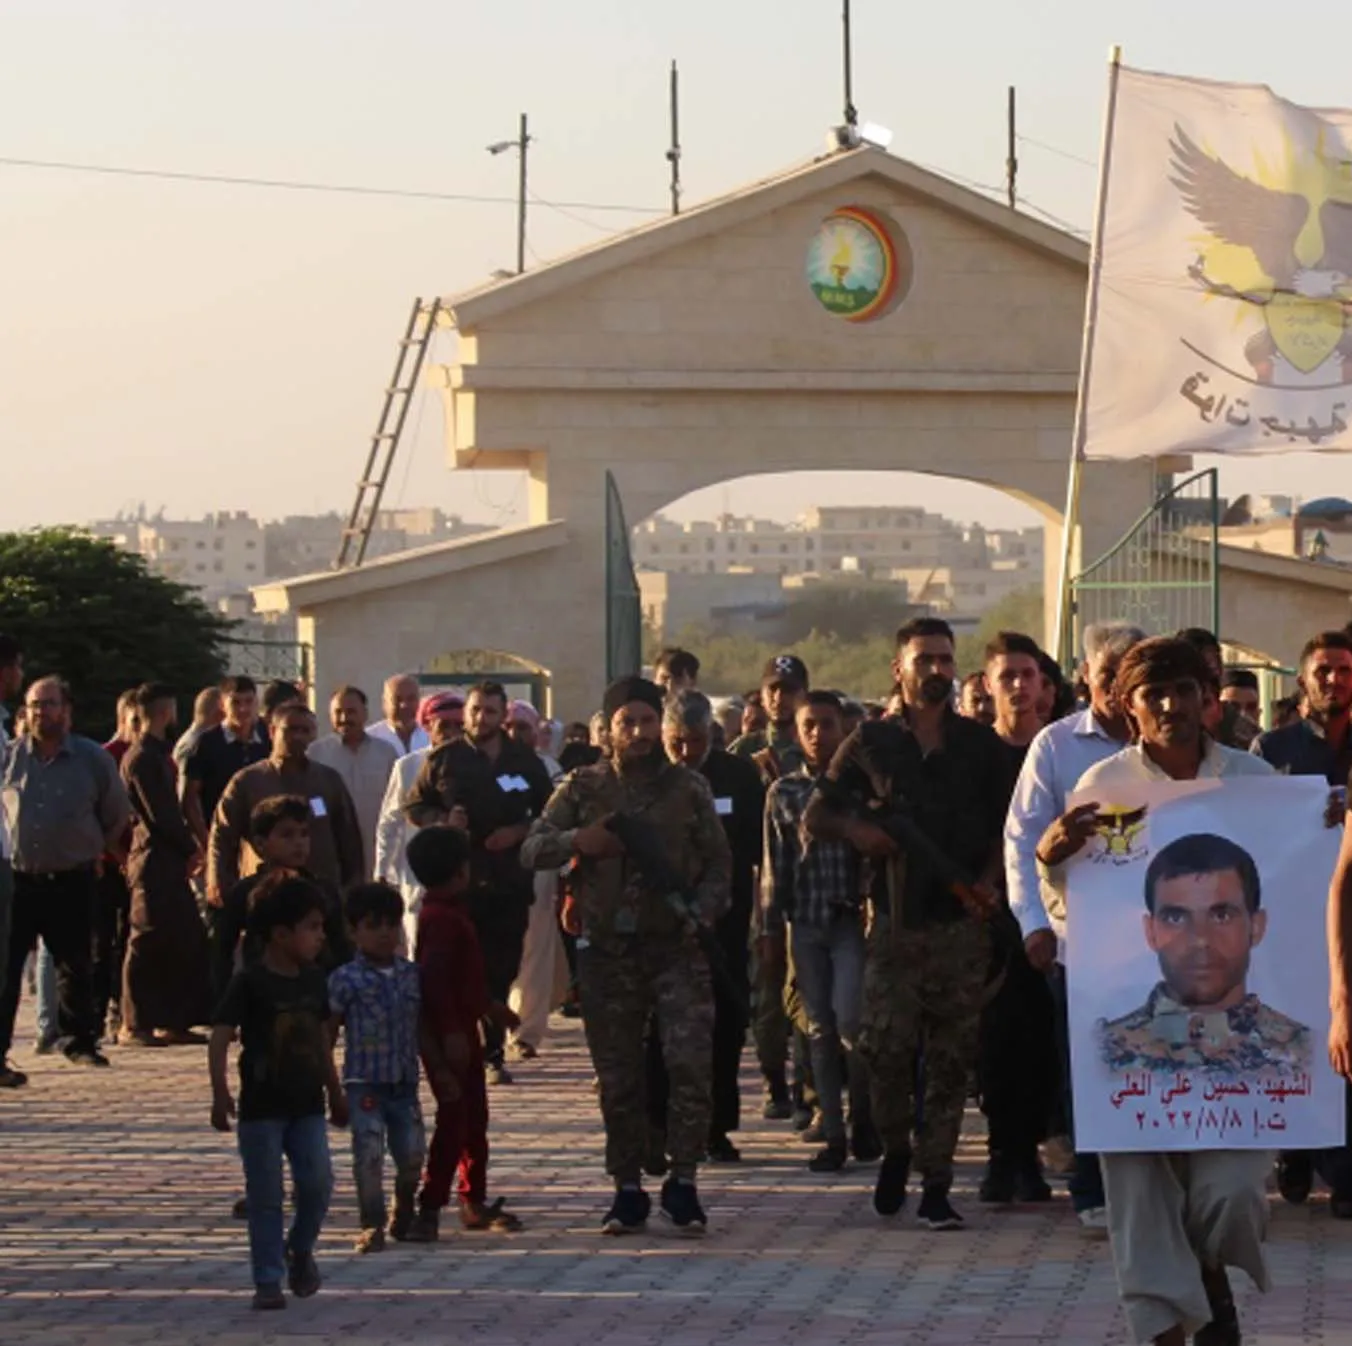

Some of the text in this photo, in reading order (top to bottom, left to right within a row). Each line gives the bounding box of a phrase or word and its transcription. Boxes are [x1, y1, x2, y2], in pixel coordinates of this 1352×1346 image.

[1110, 1072, 1152, 1110] العلي
[1160, 1072, 1192, 1107] علي
[1203, 1078, 1250, 1101] حسين
